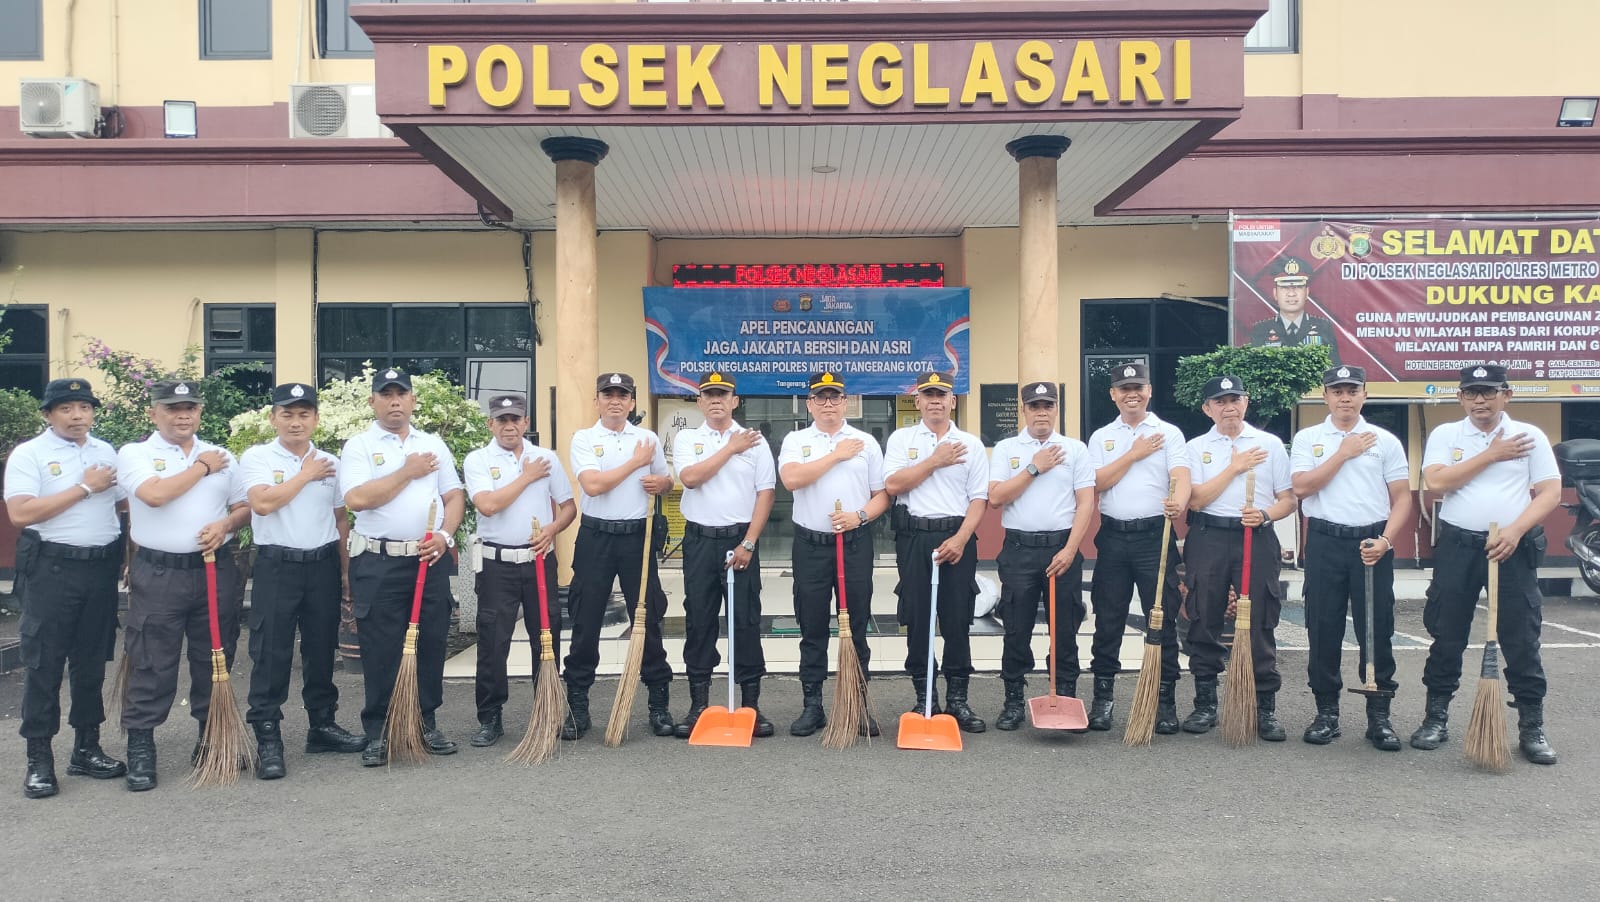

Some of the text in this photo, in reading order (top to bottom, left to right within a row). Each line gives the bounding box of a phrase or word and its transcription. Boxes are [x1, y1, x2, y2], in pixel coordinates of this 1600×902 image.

[428, 39, 1193, 109] POLSEK NEGLASARI
[1382, 229, 1539, 255] SELAMAT
[735, 264, 882, 283] POLSEK NEGLASARI
[1342, 261, 1599, 280] DI POLSEK NEGLASARI POLRES METRO
[1426, 285, 1554, 305] DUKUNG
[1355, 312, 1393, 323] GUNA
[1396, 312, 1488, 323] MEWUJUDKAN
[1491, 311, 1592, 322] PEMBANGUNAN
[740, 320, 874, 335] APEL PENCANANGAN
[1356, 326, 1600, 338] MENUJU WILAYAH BEBAS DARI KORUP
[703, 340, 912, 356] JAGA JAKARTA BERSIH DAN ASRI
[1395, 341, 1459, 352] MELAYANI
[1461, 341, 1504, 352] TANPA
[1506, 341, 1556, 352] PAMRIH
[1559, 341, 1587, 351] DAN
[680, 361, 934, 373] POLSEK NEGLASARI POLRES METRO TANGERANG KOTA
[1405, 360, 1438, 370] HOTLINE
[1548, 360, 1567, 368] CALL
